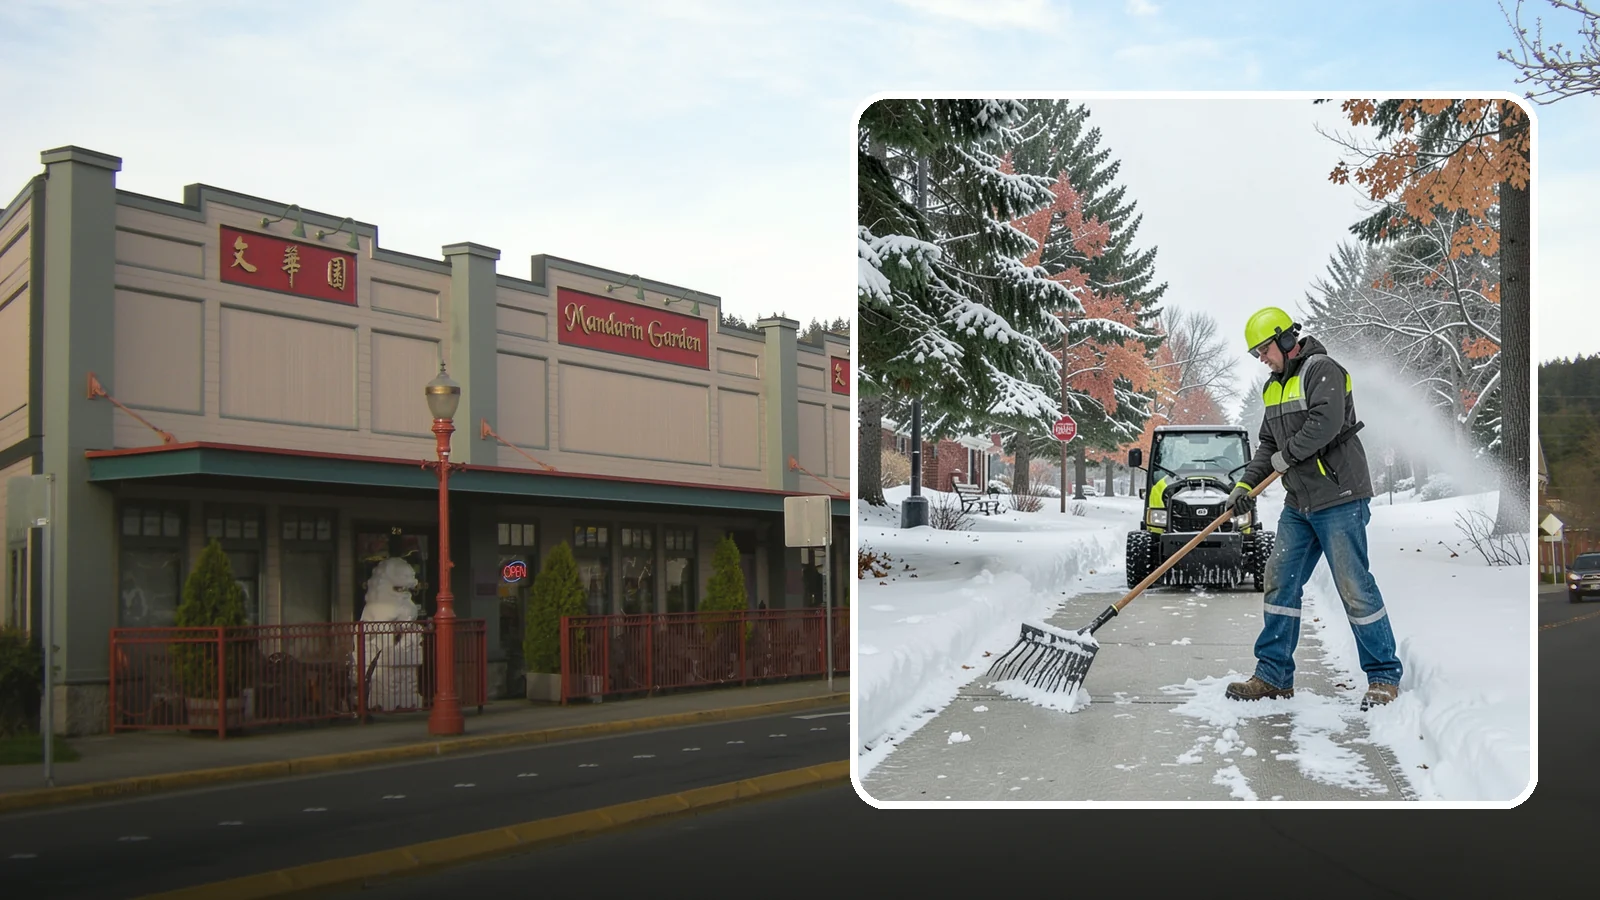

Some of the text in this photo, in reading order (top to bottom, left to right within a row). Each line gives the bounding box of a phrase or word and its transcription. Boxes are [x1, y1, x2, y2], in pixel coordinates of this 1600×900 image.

[230, 236, 347, 291] 文華園
[564, 302, 701, 352] Mandarin Garden
[835, 363, 846, 386] 文
[503, 565, 527, 579] OPEN
